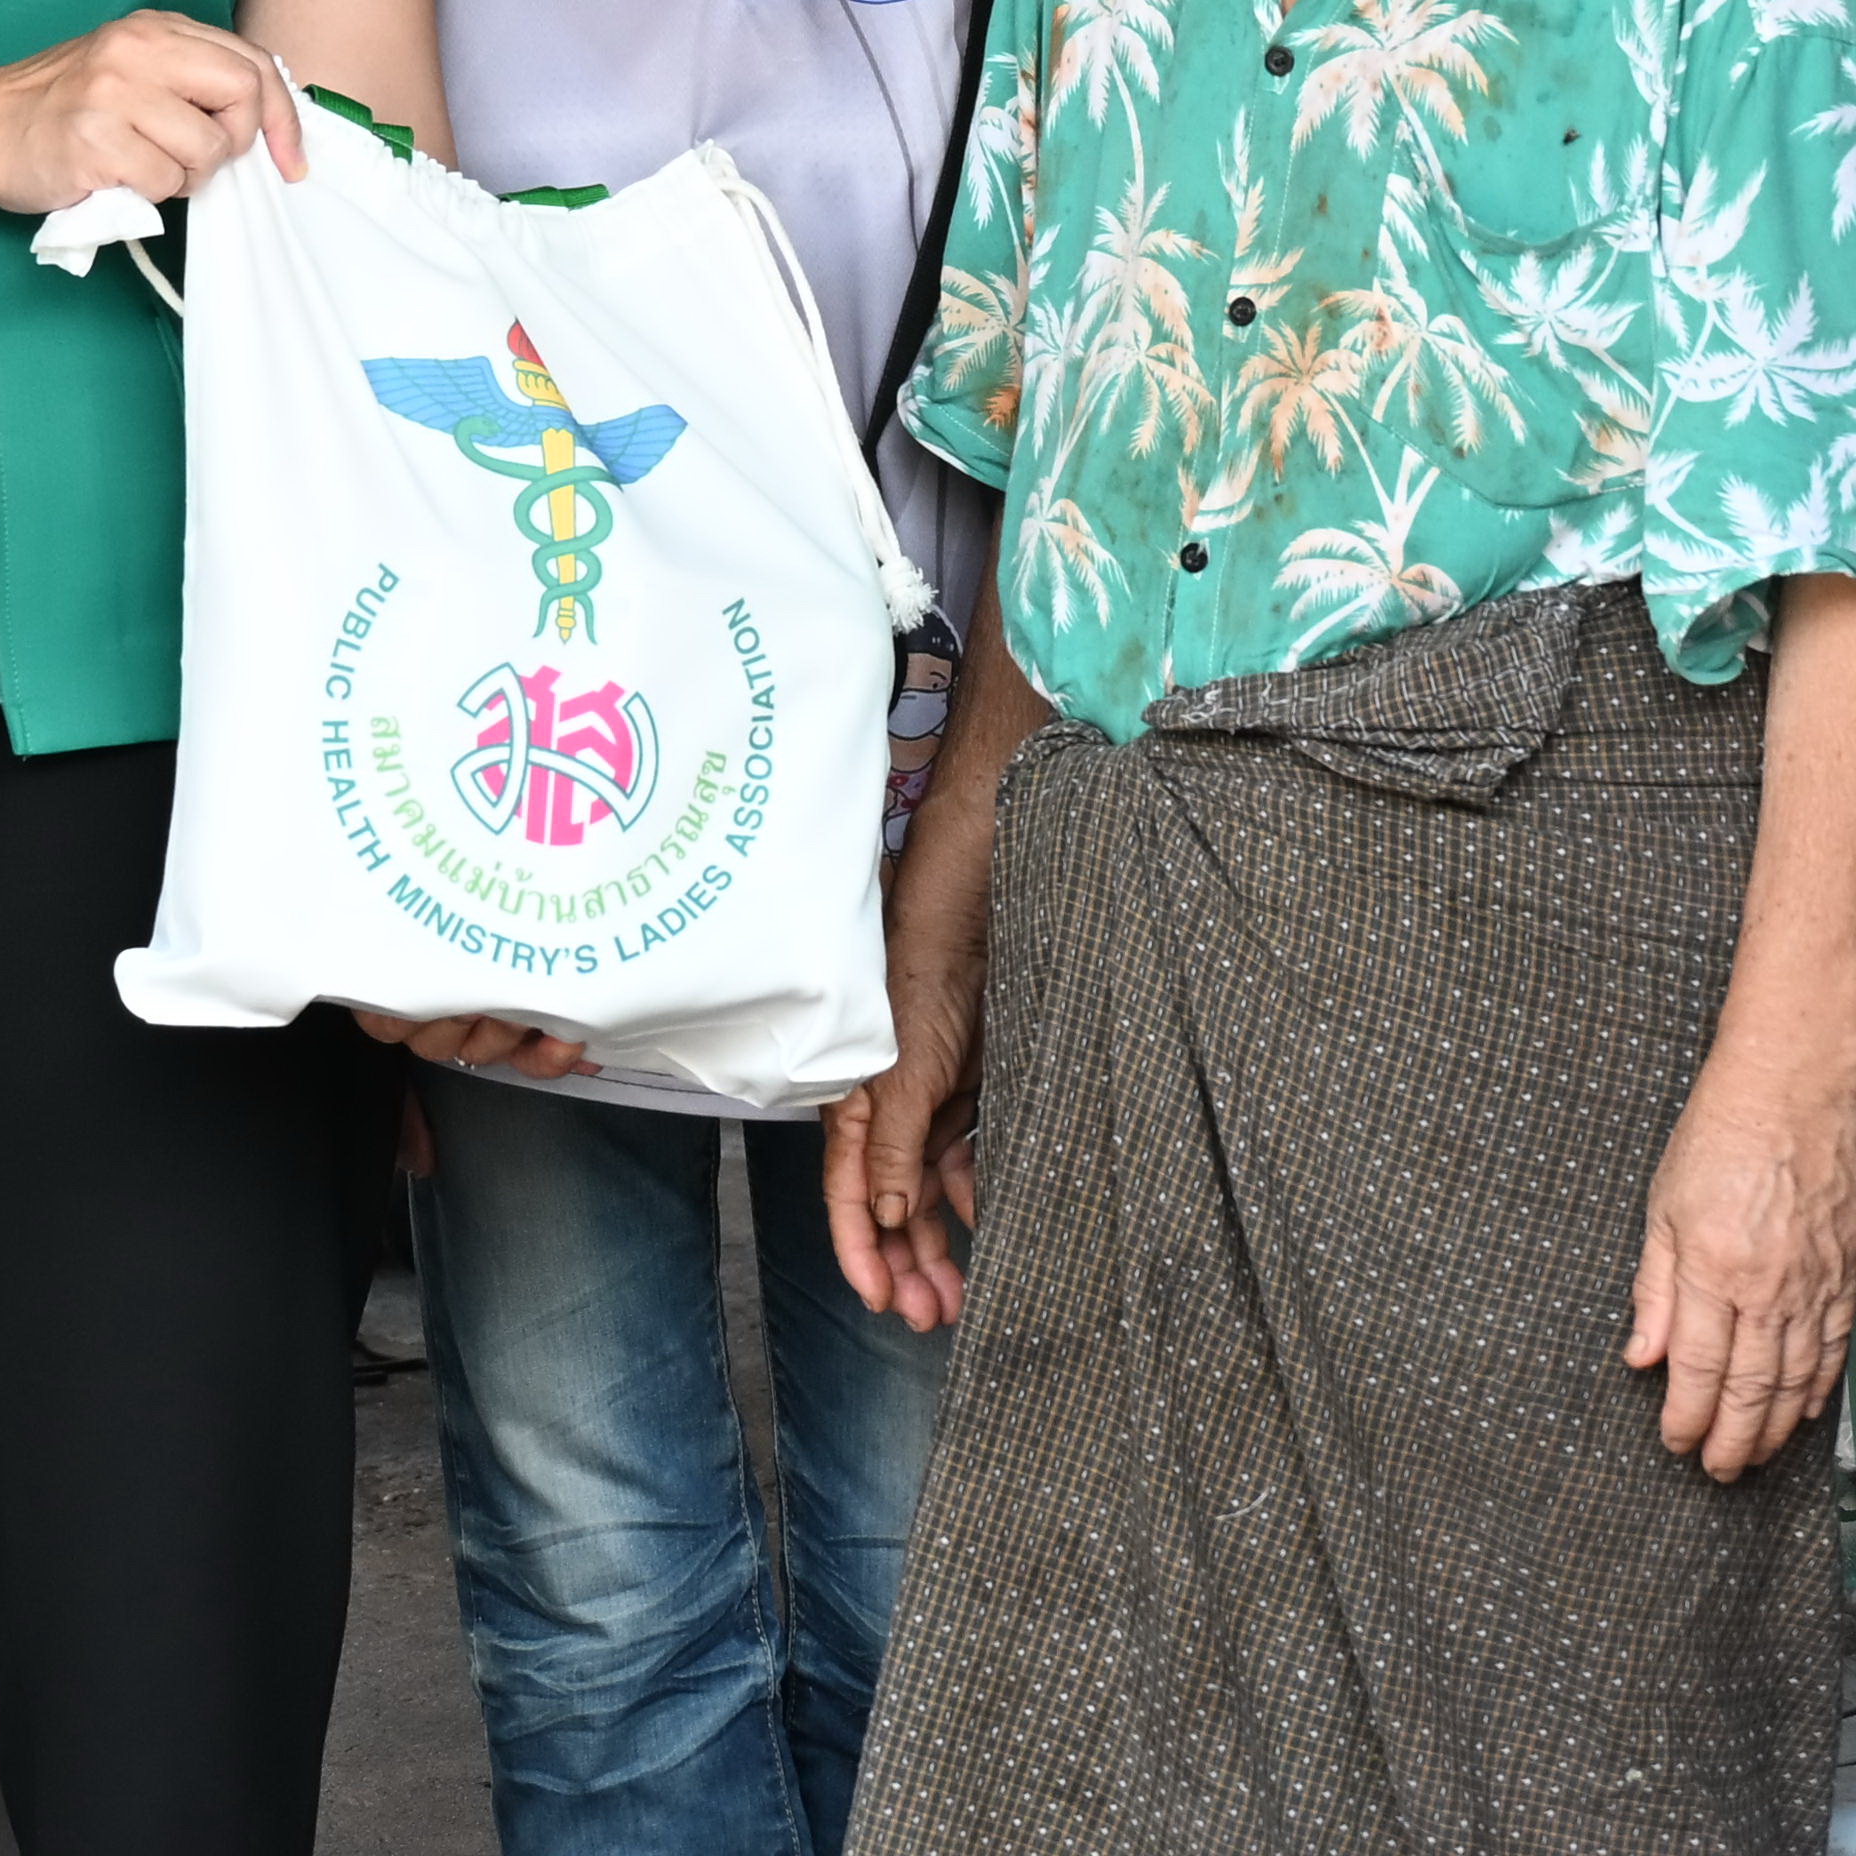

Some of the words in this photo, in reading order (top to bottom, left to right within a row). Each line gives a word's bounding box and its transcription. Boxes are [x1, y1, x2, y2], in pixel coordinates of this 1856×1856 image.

[325, 561, 400, 702] PUBLIC
[321, 719, 390, 873] HEALTH
[720, 597, 776, 858] ASSOCIATION
[370, 715, 738, 924] สมาคมแม่บ้านสาธารณสุข
[387, 874, 599, 977] MINISTRY'S
[615, 864, 731, 963] LADIES
